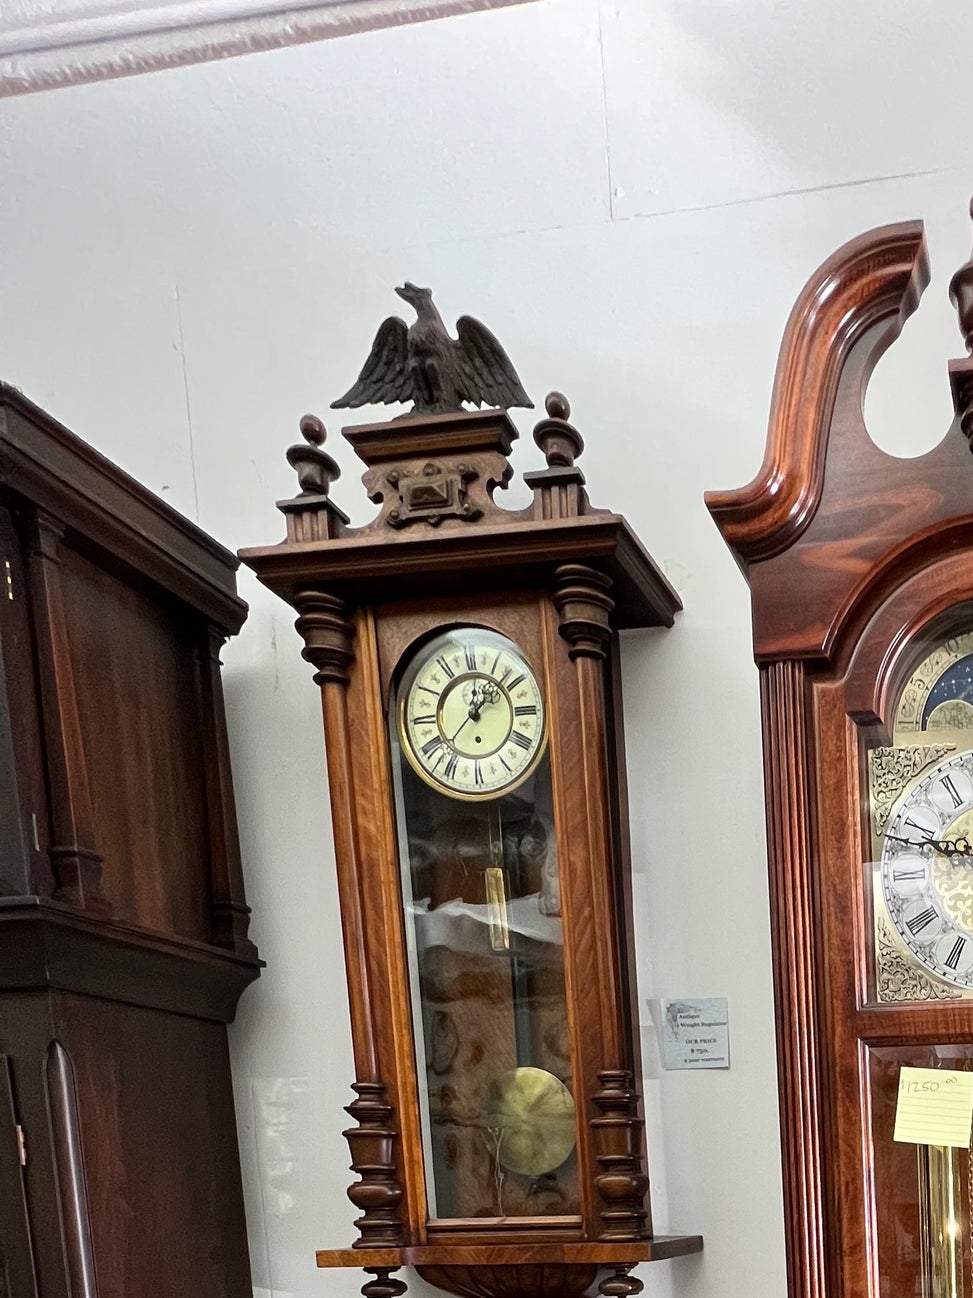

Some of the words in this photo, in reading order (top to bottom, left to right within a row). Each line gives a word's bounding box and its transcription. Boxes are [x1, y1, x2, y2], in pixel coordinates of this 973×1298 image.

[943, 637, 960, 657] 10
[491, 651, 502, 675] I
[507, 673, 528, 692] II
[911, 676, 926, 690] 5
[514, 705, 537, 717] III
[509, 730, 533, 751] IIII
[939, 775, 965, 808] XI
[904, 818, 936, 842] X
[893, 868, 926, 882] IX
[906, 908, 939, 936] VIII
[945, 935, 966, 970] VII
